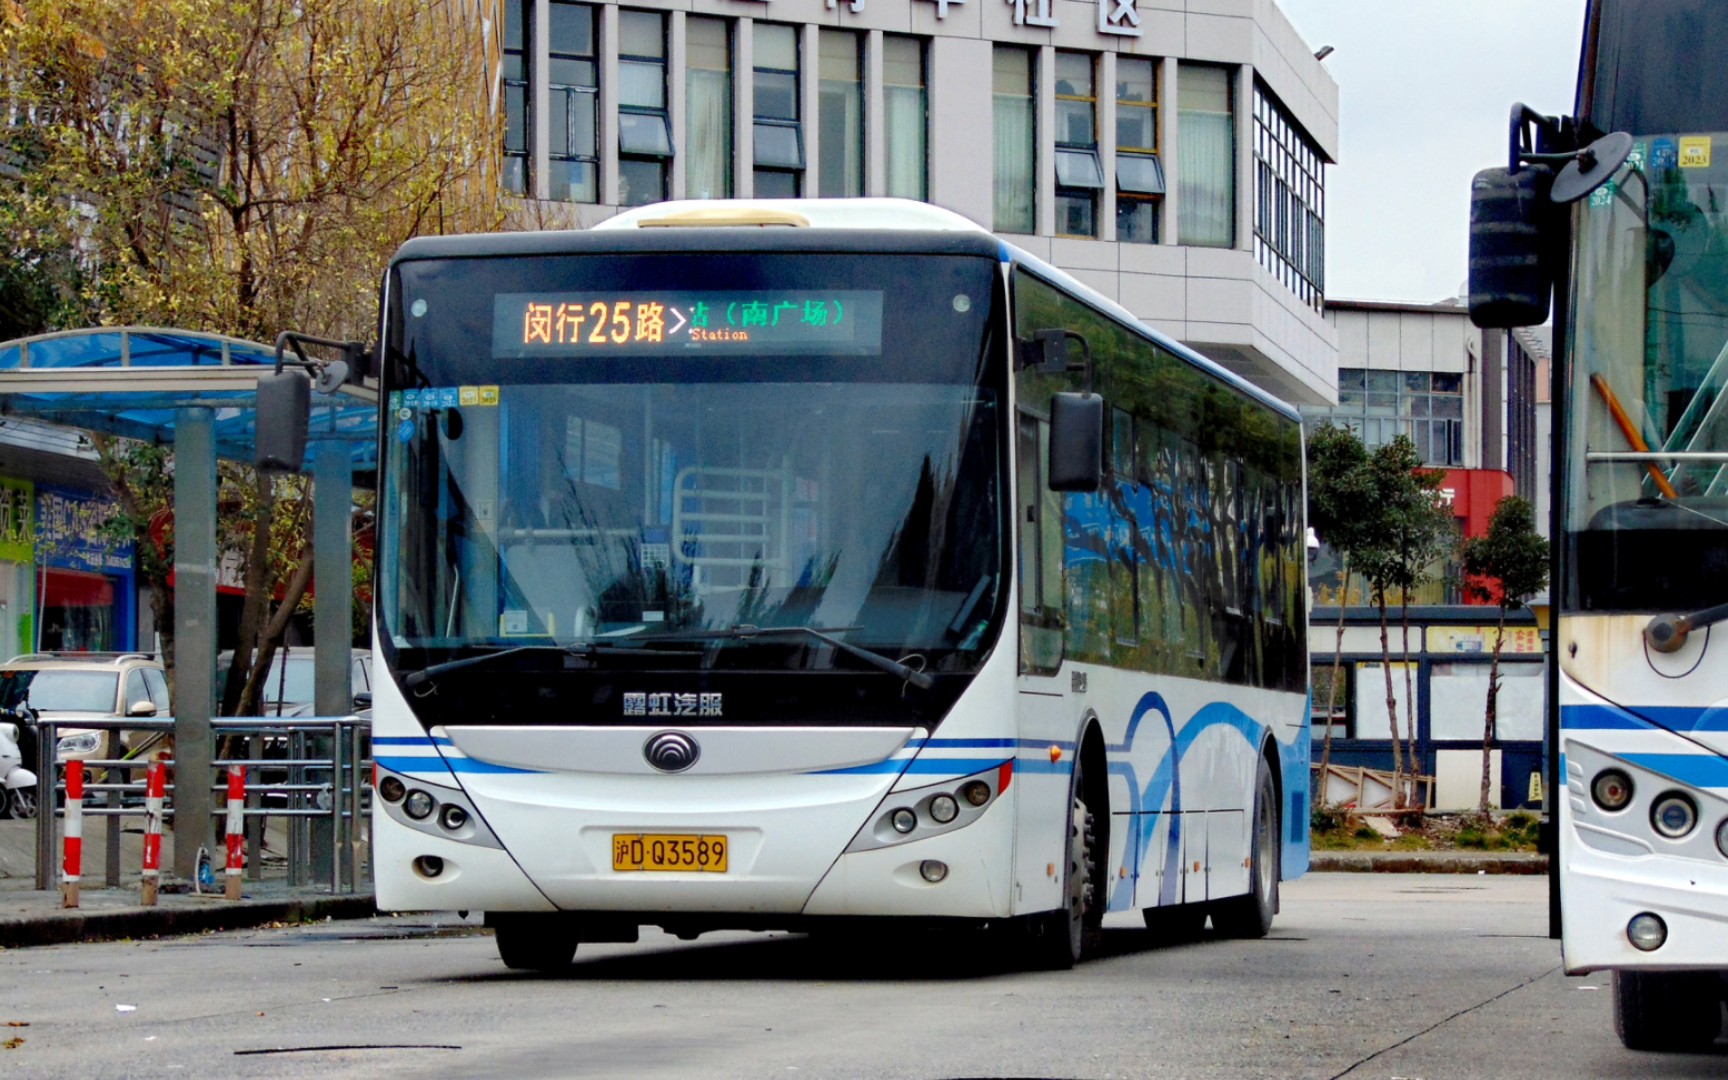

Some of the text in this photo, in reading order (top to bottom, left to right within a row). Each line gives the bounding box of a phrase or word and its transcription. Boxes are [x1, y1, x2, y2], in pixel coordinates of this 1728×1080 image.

[524, 302, 665, 343] 闵行25路
[692, 328, 748, 340] Station
